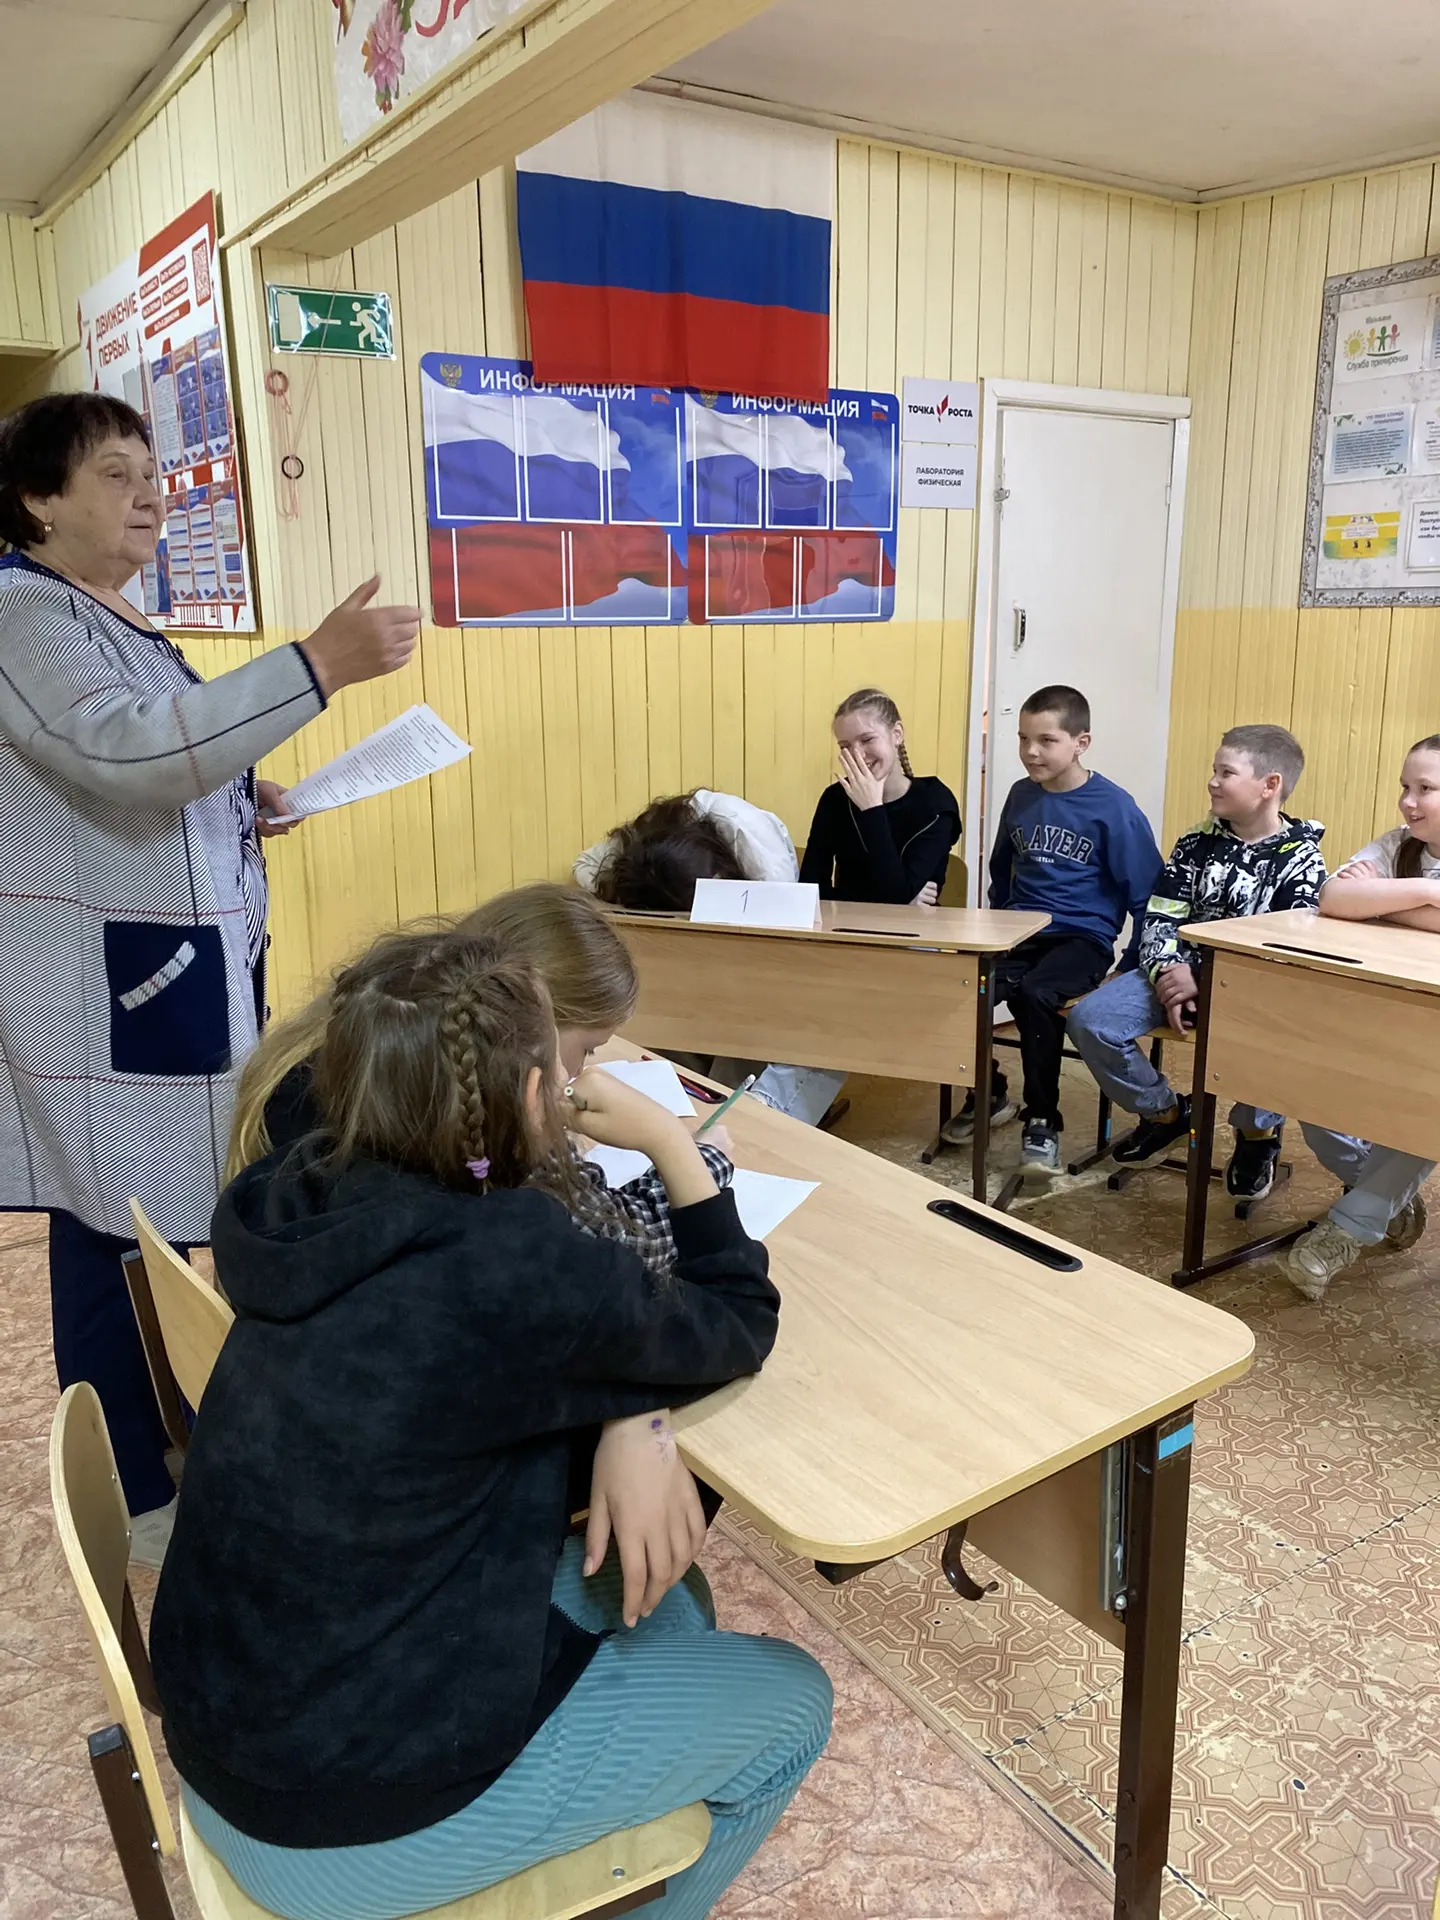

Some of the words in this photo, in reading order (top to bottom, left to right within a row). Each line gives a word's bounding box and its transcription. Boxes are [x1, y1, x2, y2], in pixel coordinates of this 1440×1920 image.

[95, 292, 138, 342] ДВИЖЕНИЕ
[98, 331, 130, 368] ПЕРВЫХ
[1346, 359, 1370, 372] Служба
[732, 392, 860, 419] ИНФОРМАЦИЯ
[908, 404, 935, 415] ТОЧКА
[947, 408, 973, 418] РОСТА
[915, 467, 964, 476] ЛАБОРАТОРИЯ
[917, 478, 962, 487] ФИЗИЧЕСКАЯ
[741, 889, 749, 914] 1
